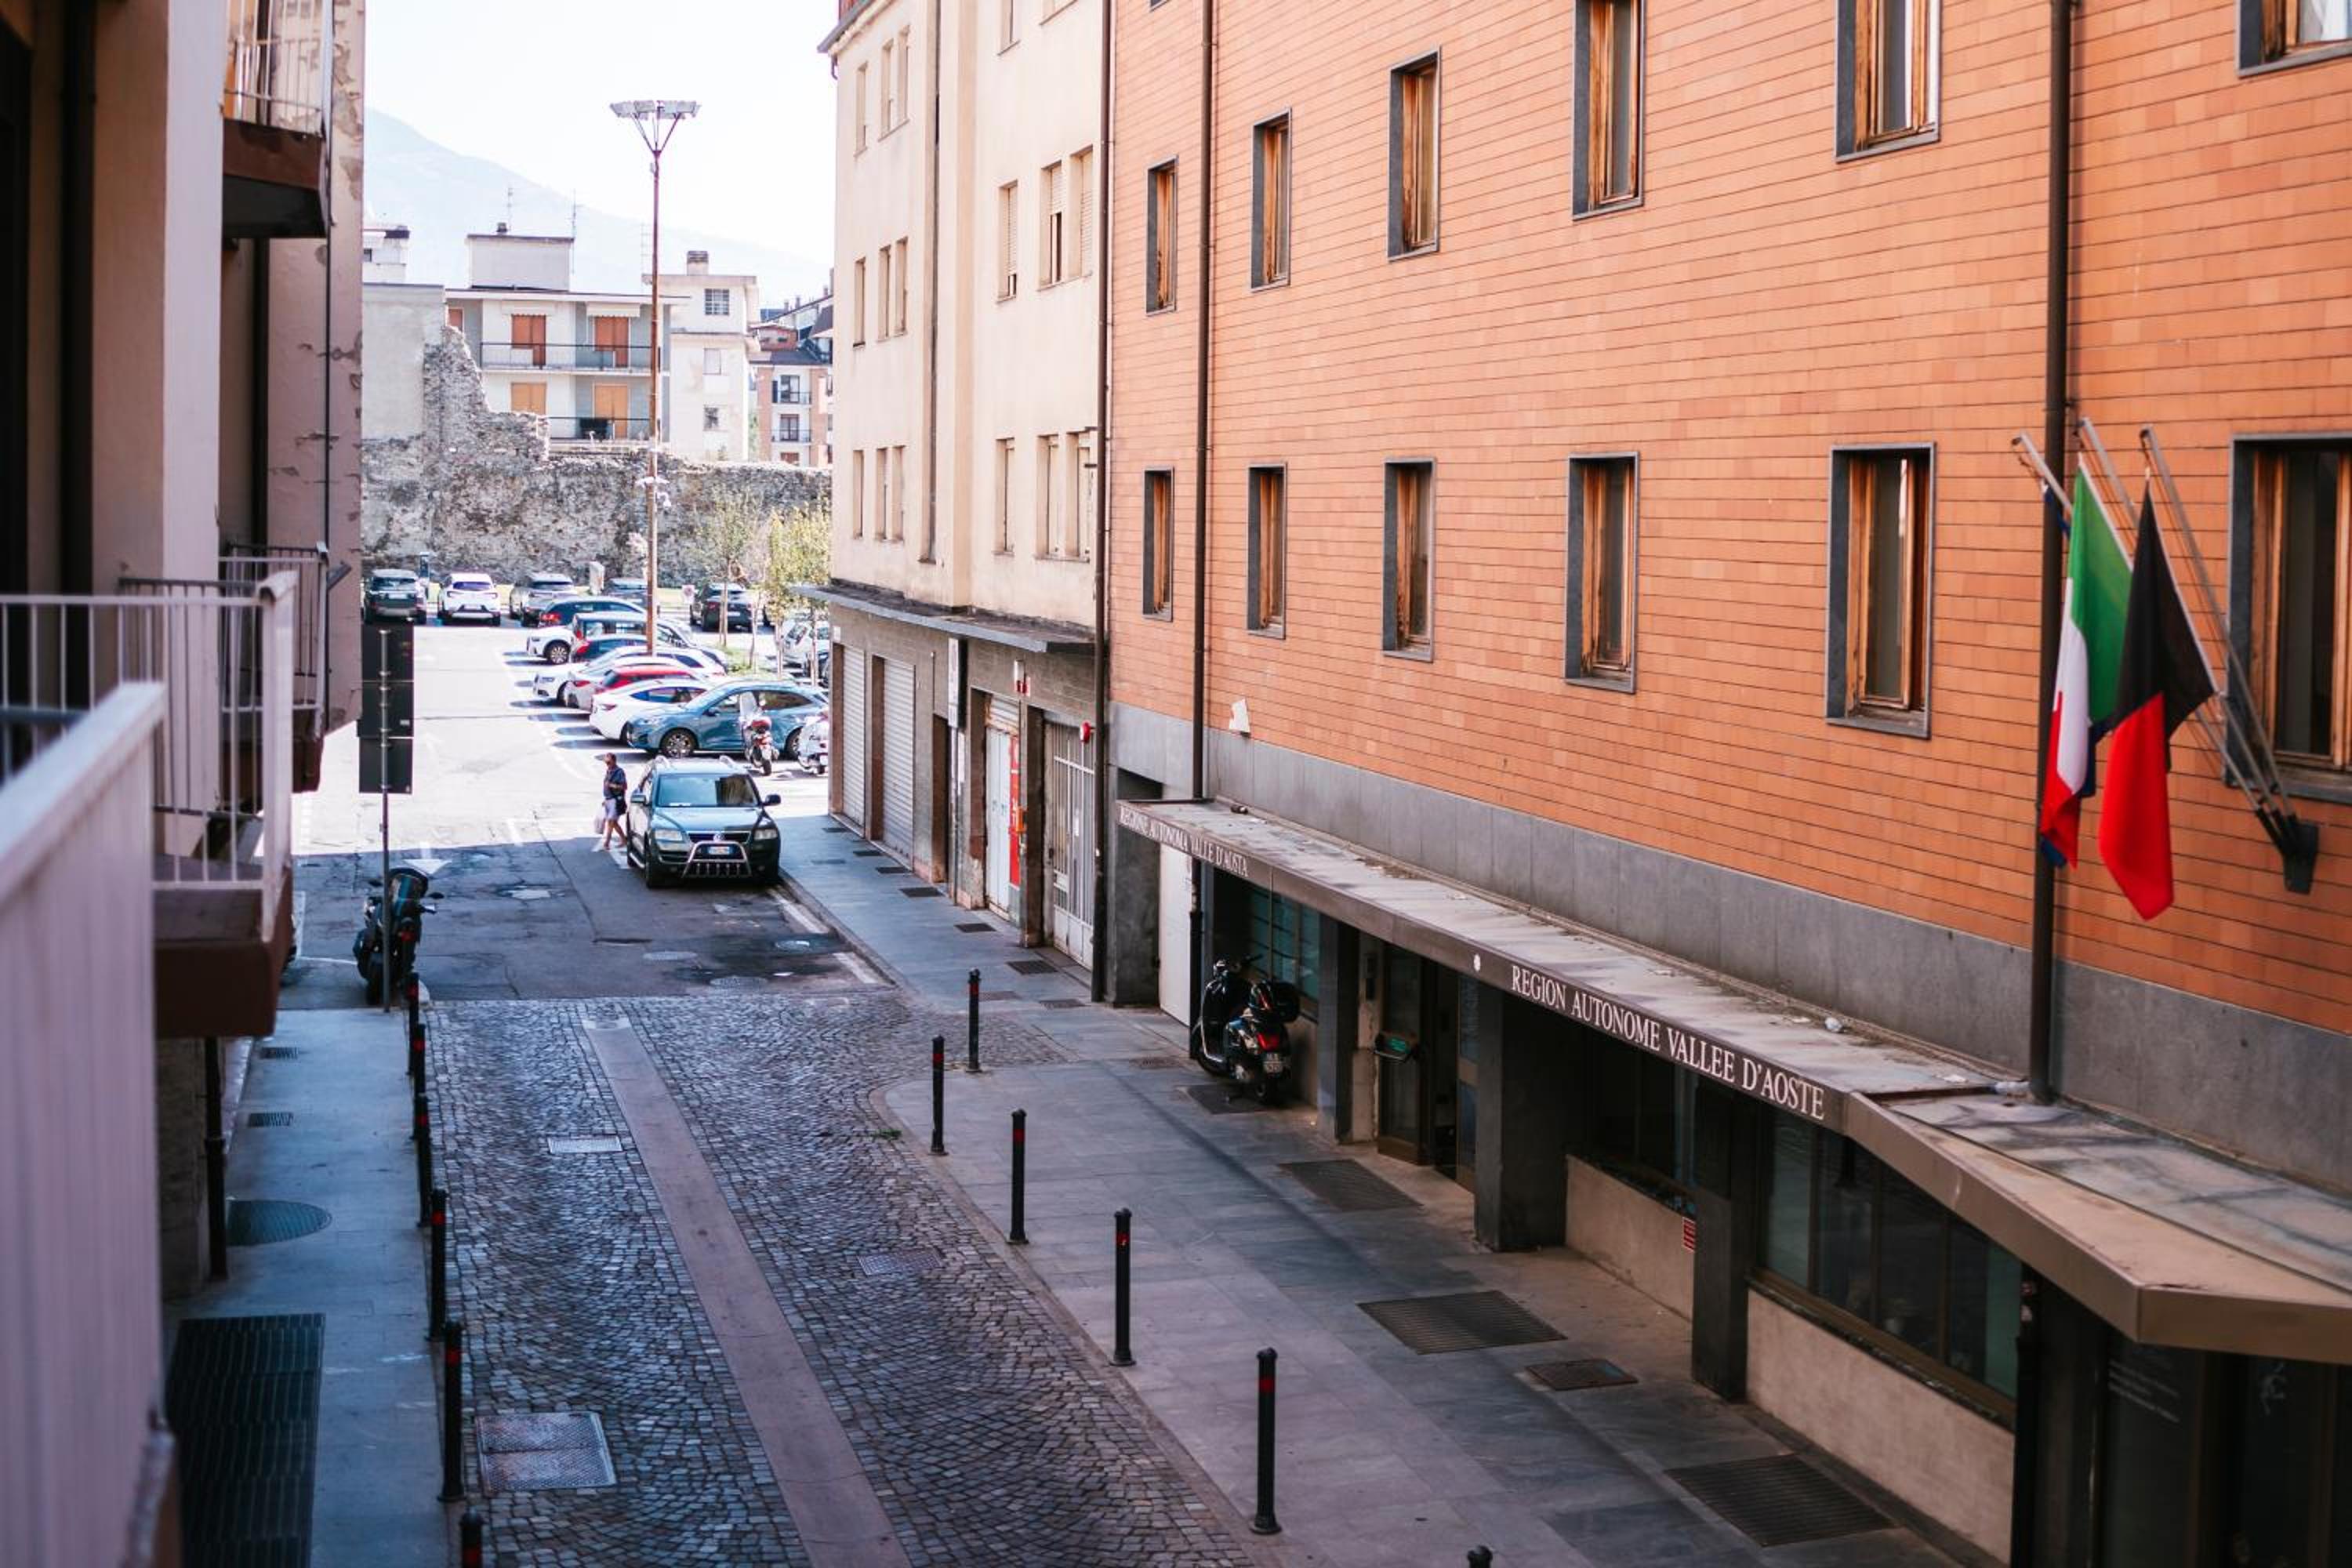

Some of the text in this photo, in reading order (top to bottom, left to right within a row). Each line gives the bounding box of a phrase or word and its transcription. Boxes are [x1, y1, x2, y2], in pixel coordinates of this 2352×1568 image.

[1120, 806, 1248, 877] REGIONE AUTONOMA VALLE D'AOSTA
[1512, 965, 1824, 1121] REGION AUTONOME VALLEE D'AOSTE
